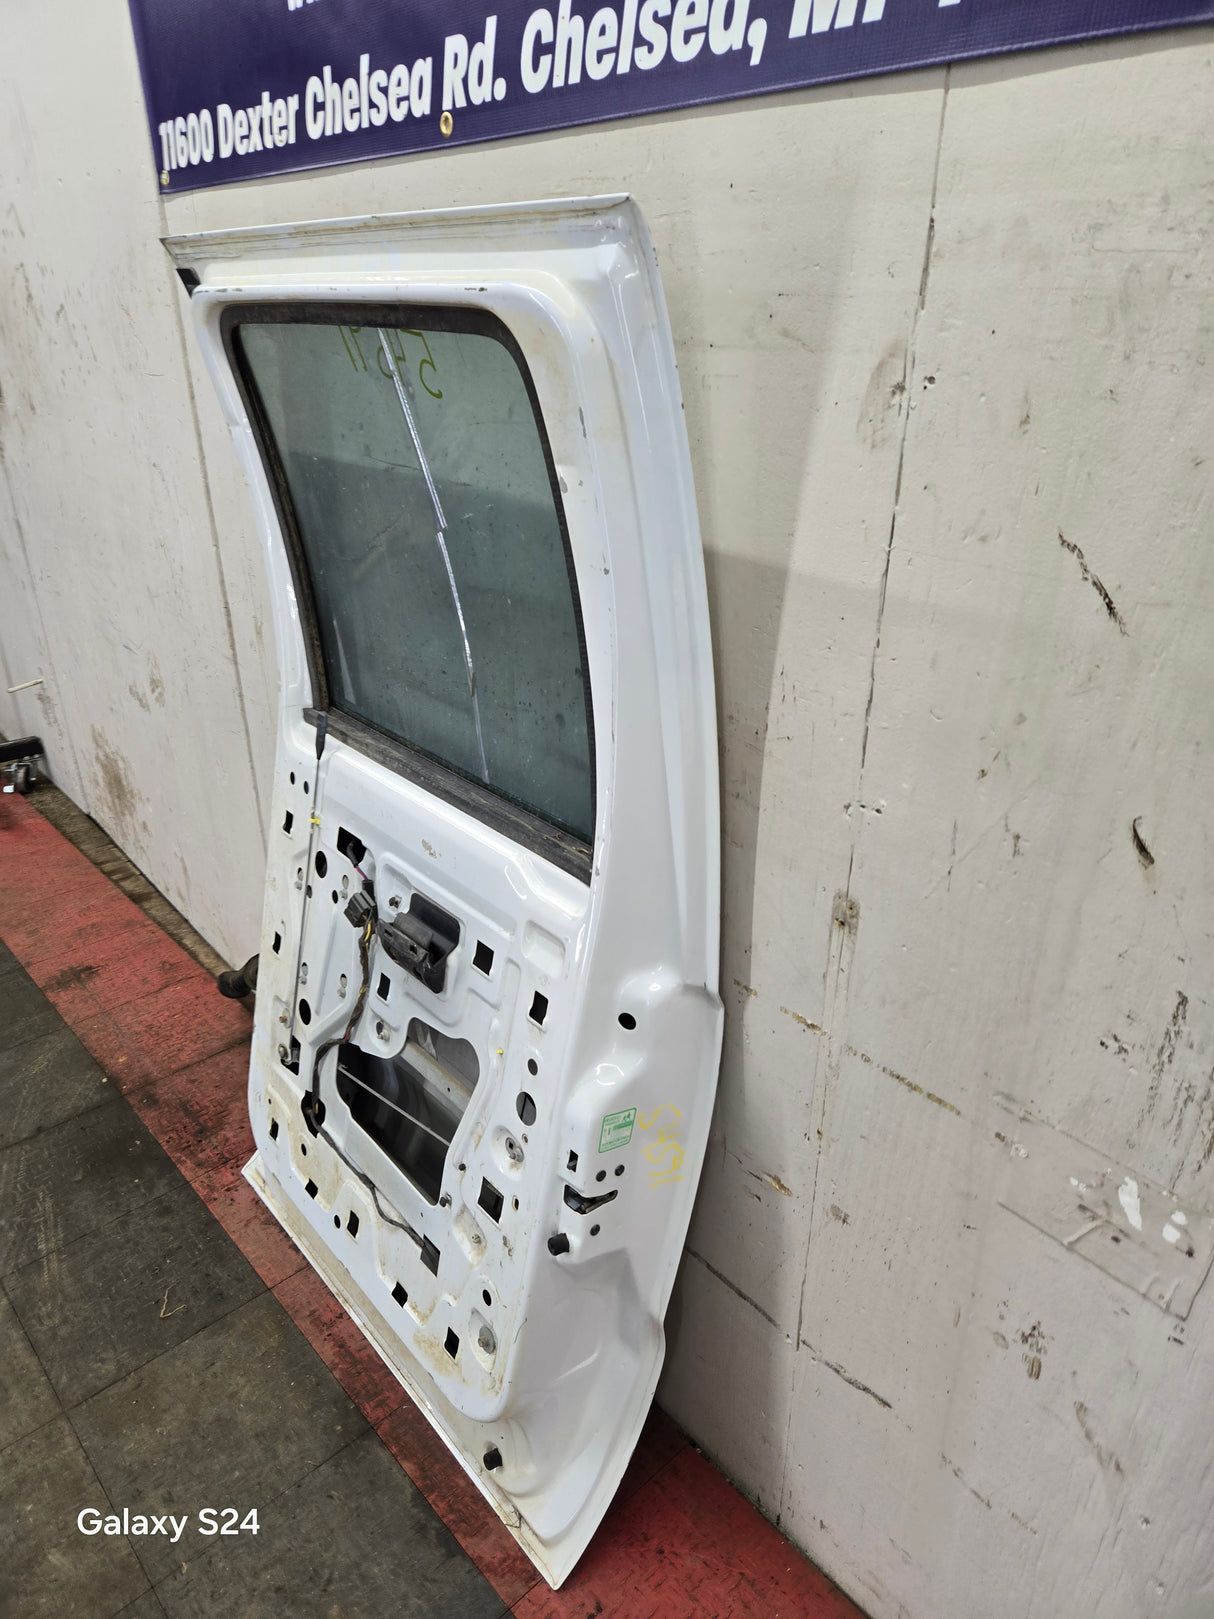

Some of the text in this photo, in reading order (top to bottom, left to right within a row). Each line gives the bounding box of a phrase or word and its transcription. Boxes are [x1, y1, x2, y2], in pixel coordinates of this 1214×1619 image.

[158, 108, 214, 171] 11600
[217, 91, 299, 159] Dexter
[305, 53, 432, 140] Chelsea
[442, 15, 506, 111] Rd.
[520, 0, 768, 94] Chelsea,
